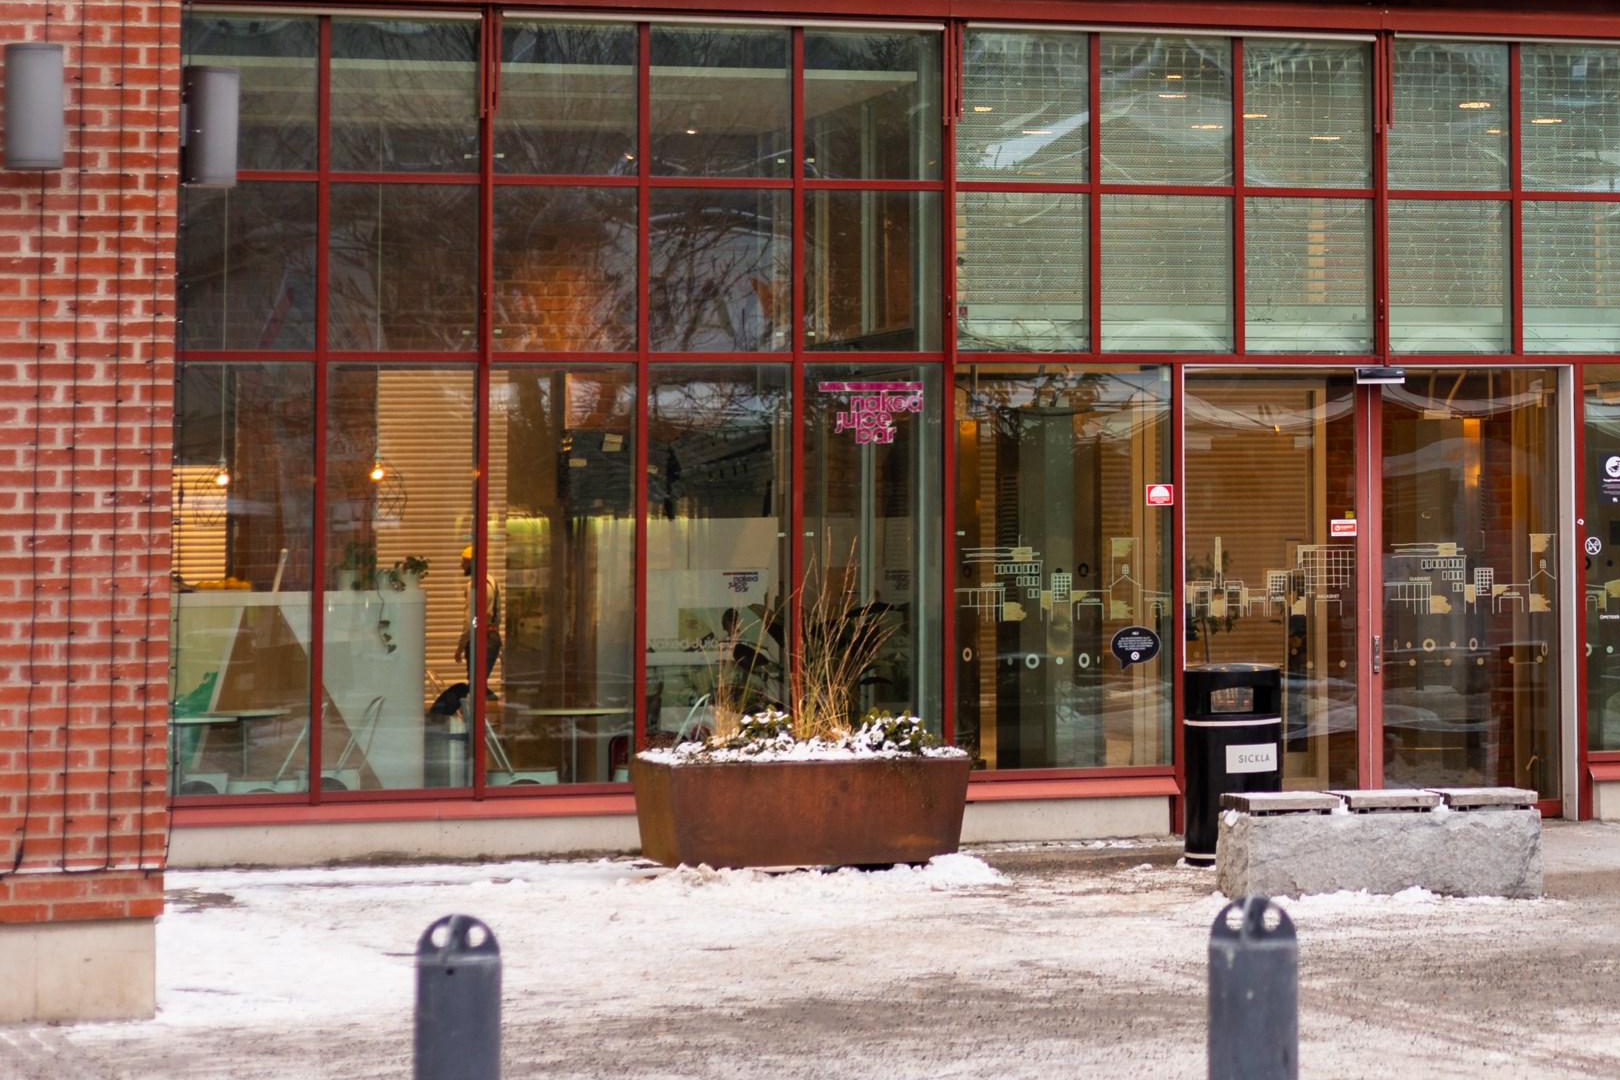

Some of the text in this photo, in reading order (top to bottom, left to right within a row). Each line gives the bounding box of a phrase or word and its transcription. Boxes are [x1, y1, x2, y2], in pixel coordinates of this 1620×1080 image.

[851, 389, 923, 412] naked
[834, 412, 892, 433] juice
[856, 427, 897, 444] bar
[1238, 753, 1271, 764] SICKLA
